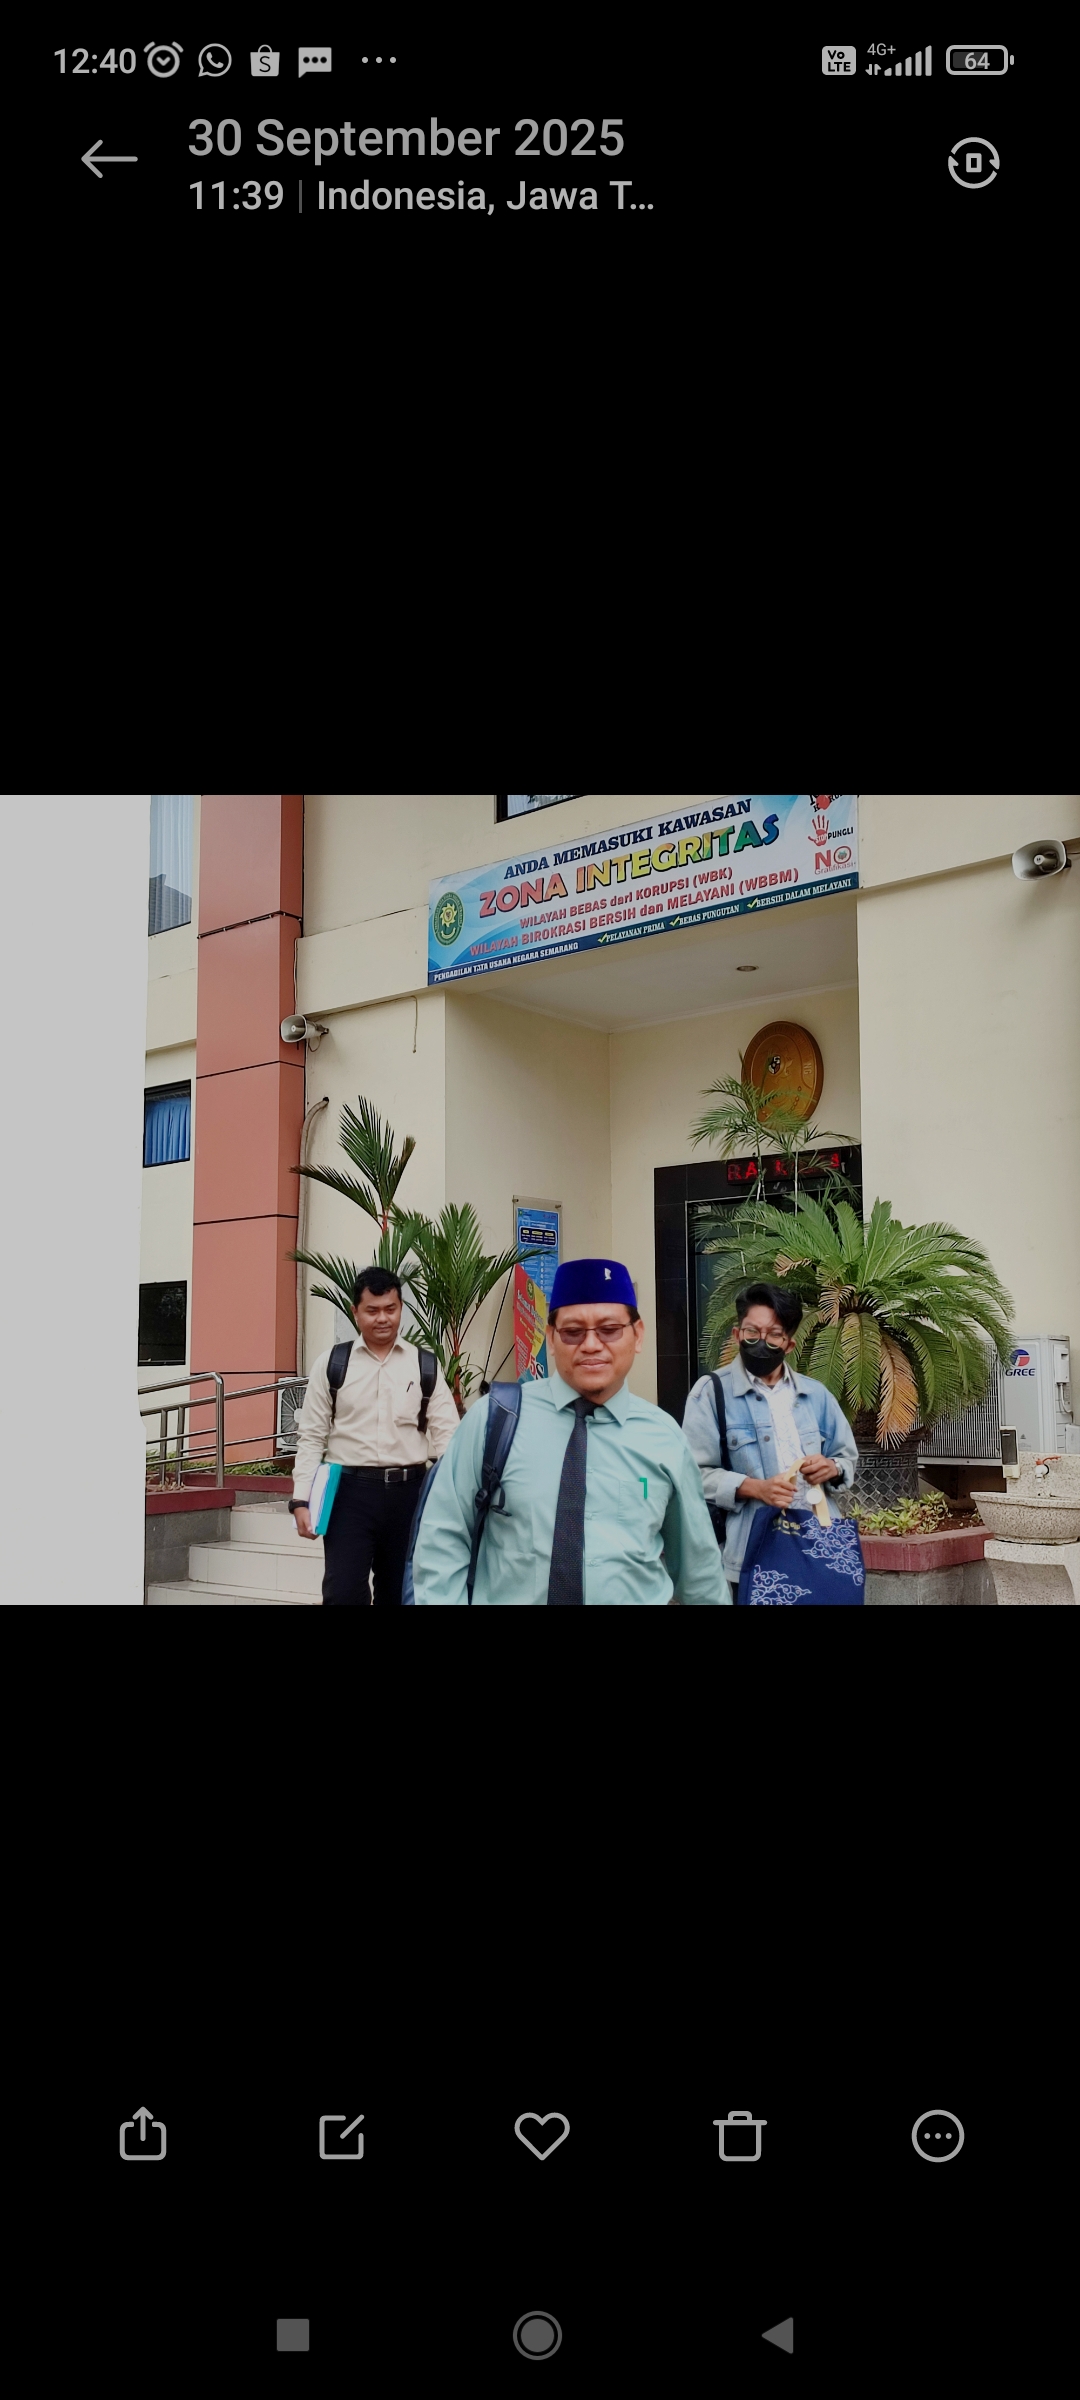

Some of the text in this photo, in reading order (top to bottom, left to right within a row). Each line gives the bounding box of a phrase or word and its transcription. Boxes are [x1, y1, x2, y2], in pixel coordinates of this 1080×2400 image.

[503, 798, 752, 879] ANDA MEMASUKI KAWASAN
[827, 826, 854, 840] PUNGLI
[480, 813, 780, 918] ZONA INTEGRITAS
[519, 908, 567, 929] WILAYAH
[569, 898, 608, 918] BEBAS
[635, 877, 690, 901] KORUPSI
[692, 866, 733, 889] (WBK)
[755, 878, 852, 908] BERSIH DALAM MELAYANI
[469, 868, 799, 957] WILAYAH BIROKRASI BERSIH dan MELAYANI (WBBM)
[678, 904, 740, 926] BEBAS PUNGUTAN
[605, 921, 666, 943] PELAYANAN PRIMA
[433, 941, 579, 982] PENGADILAN TATA USAHA NEGARA SEMARANG
[1005, 1368, 1036, 1377] GREE
